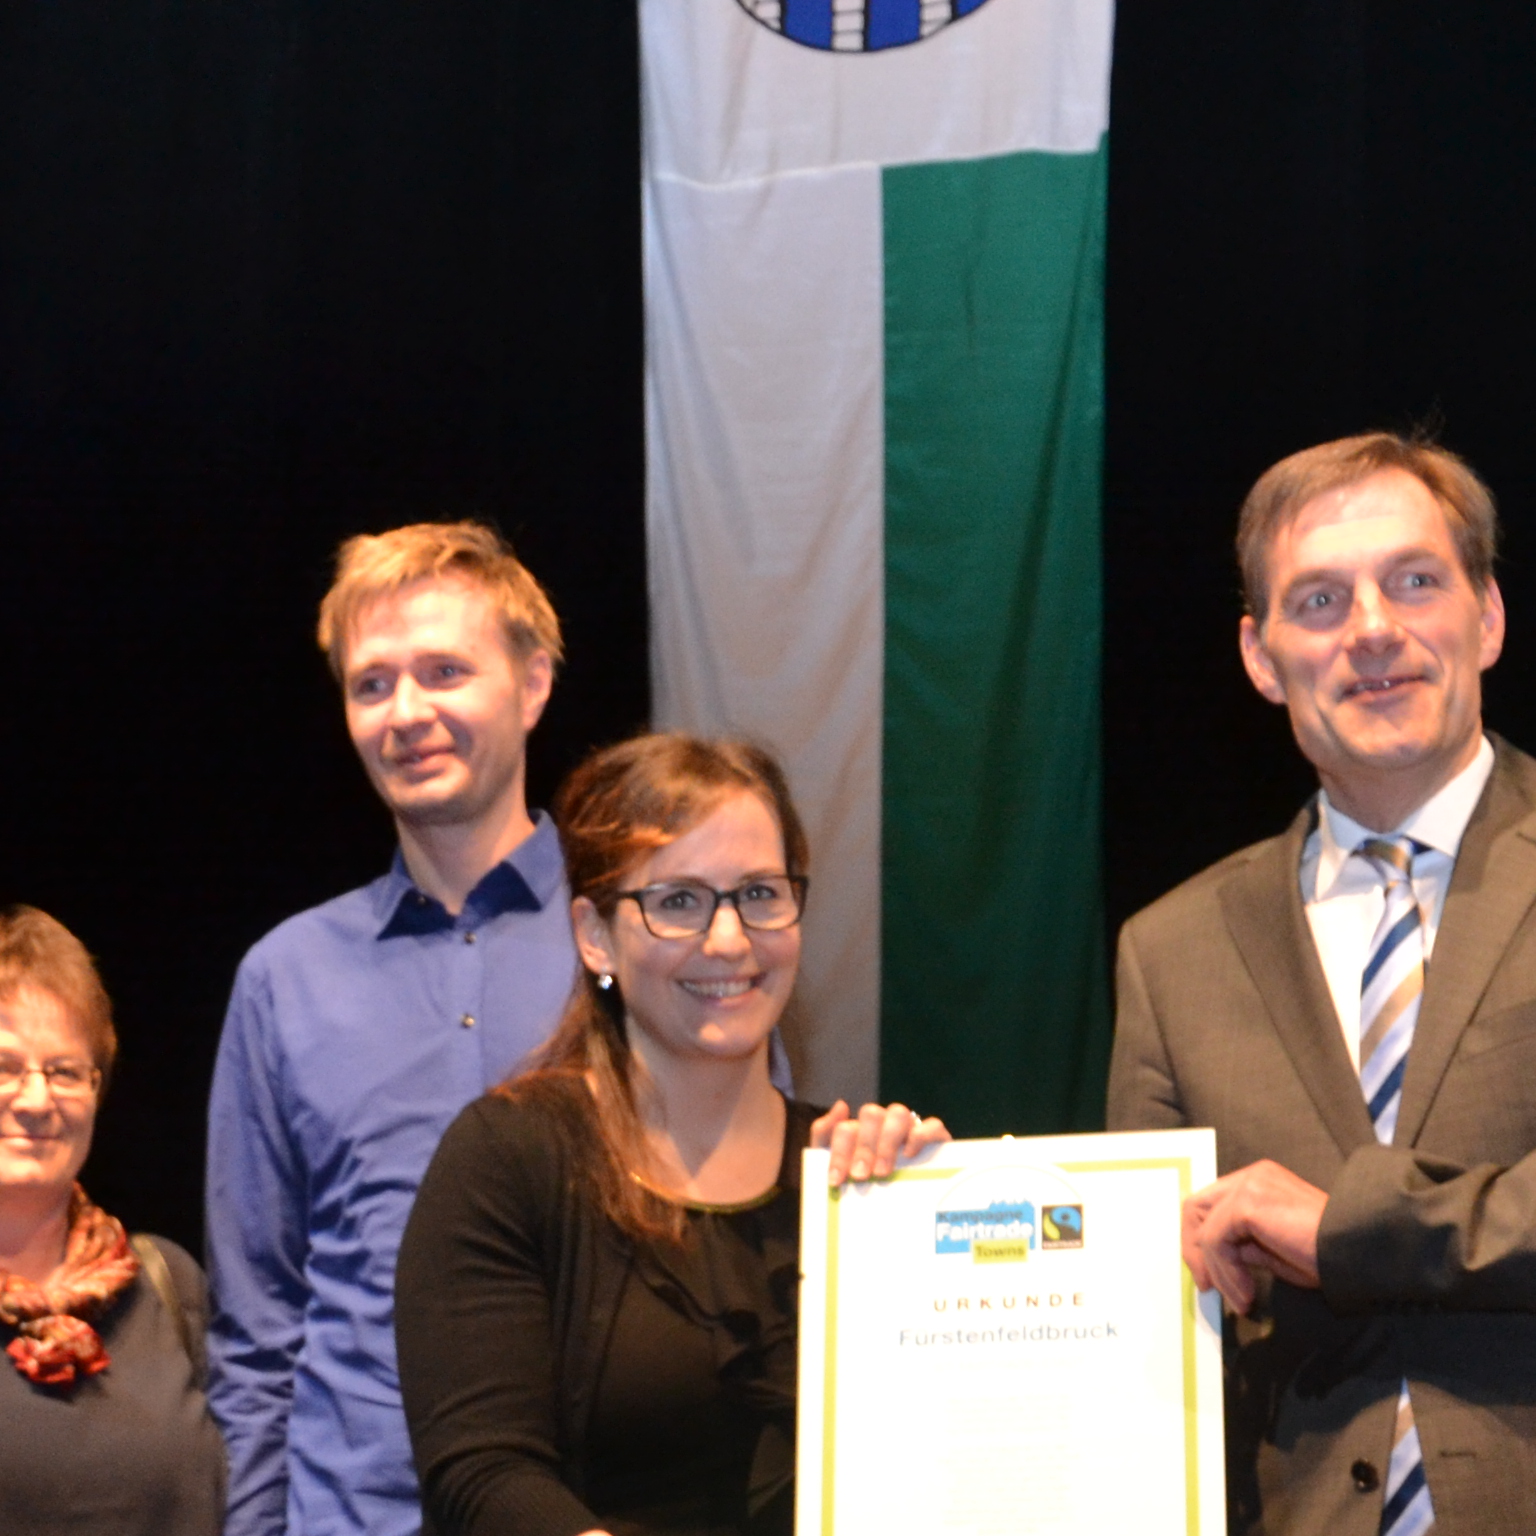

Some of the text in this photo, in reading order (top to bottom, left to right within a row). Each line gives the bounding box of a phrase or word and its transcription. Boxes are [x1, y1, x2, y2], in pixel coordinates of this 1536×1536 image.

[937, 1210, 1024, 1224] Kampagne
[935, 1220, 1035, 1242] Fairtrade
[974, 1245, 1026, 1258] Towns
[933, 1292, 1085, 1312] URKUNDE
